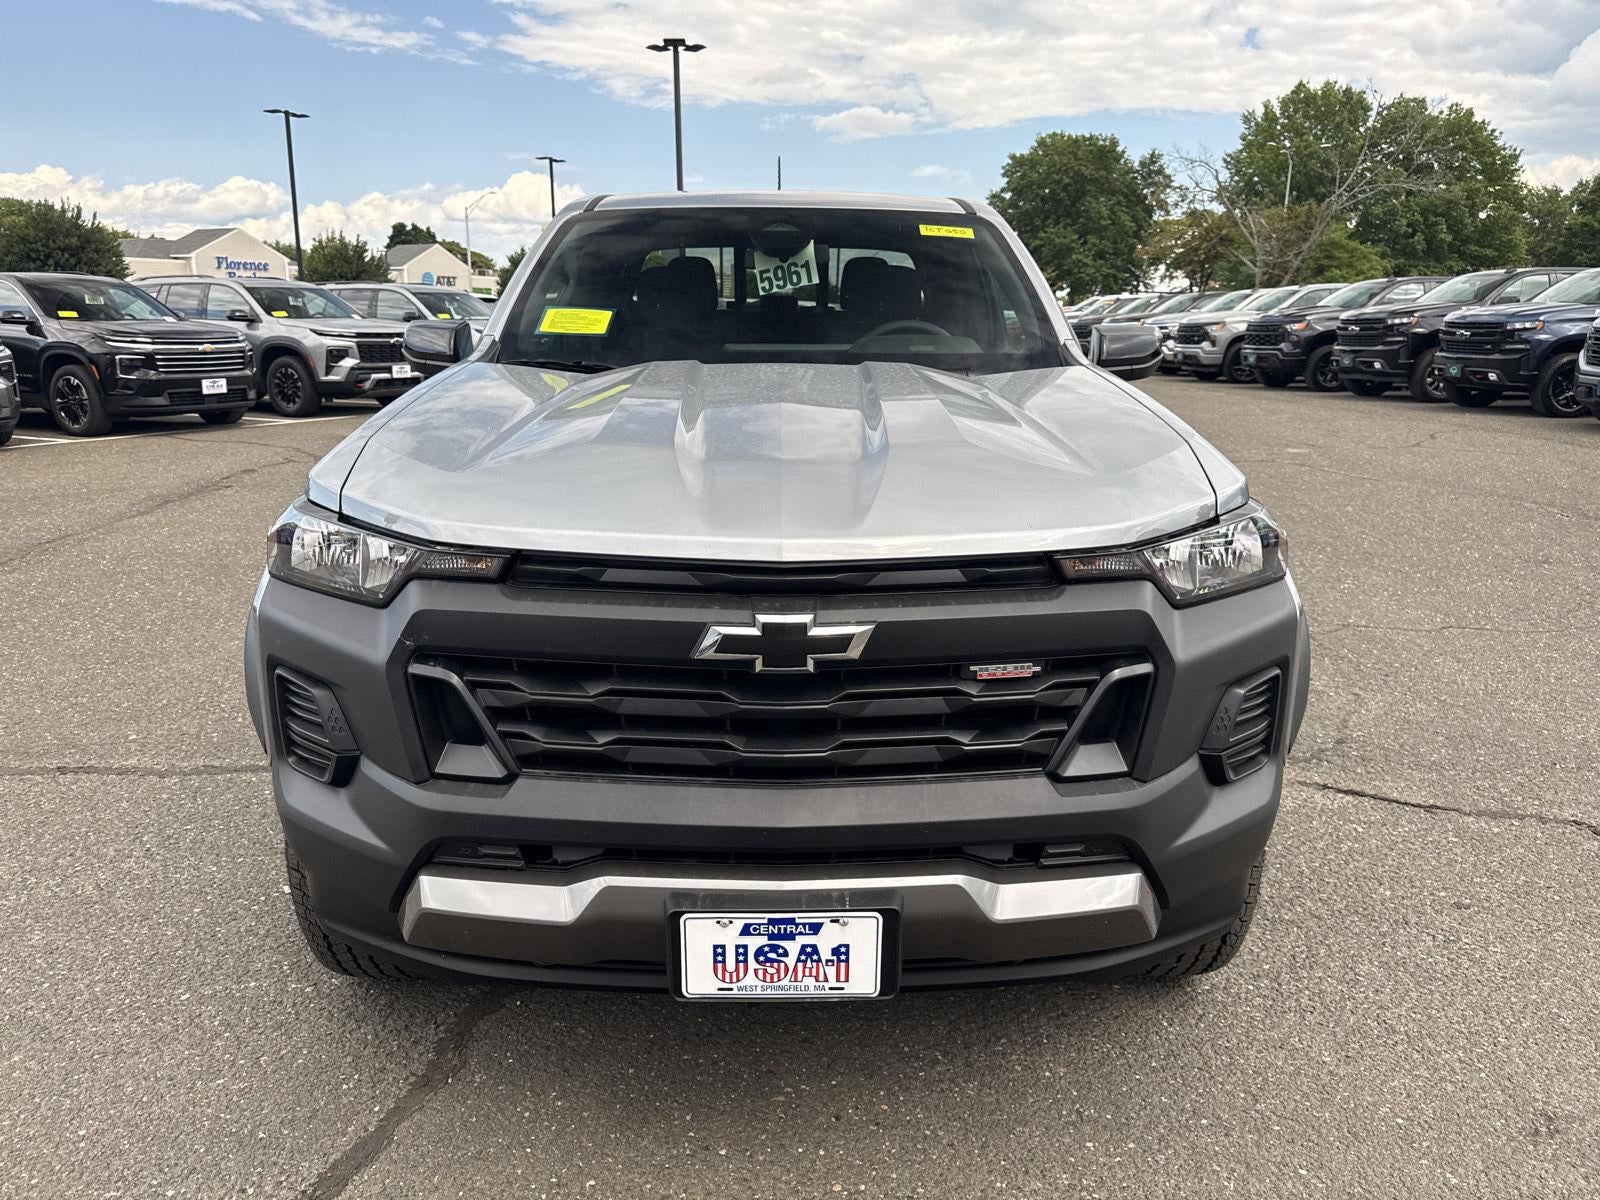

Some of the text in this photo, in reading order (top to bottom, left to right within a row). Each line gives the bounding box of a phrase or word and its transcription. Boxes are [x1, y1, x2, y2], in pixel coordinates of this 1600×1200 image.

[215, 256, 269, 271] Florence
[436, 275, 457, 286] AT&T
[759, 260, 813, 293] 5961
[749, 924, 814, 934] CENTRAL
[736, 984, 827, 993] WEST SPRINGFIELD, MA
